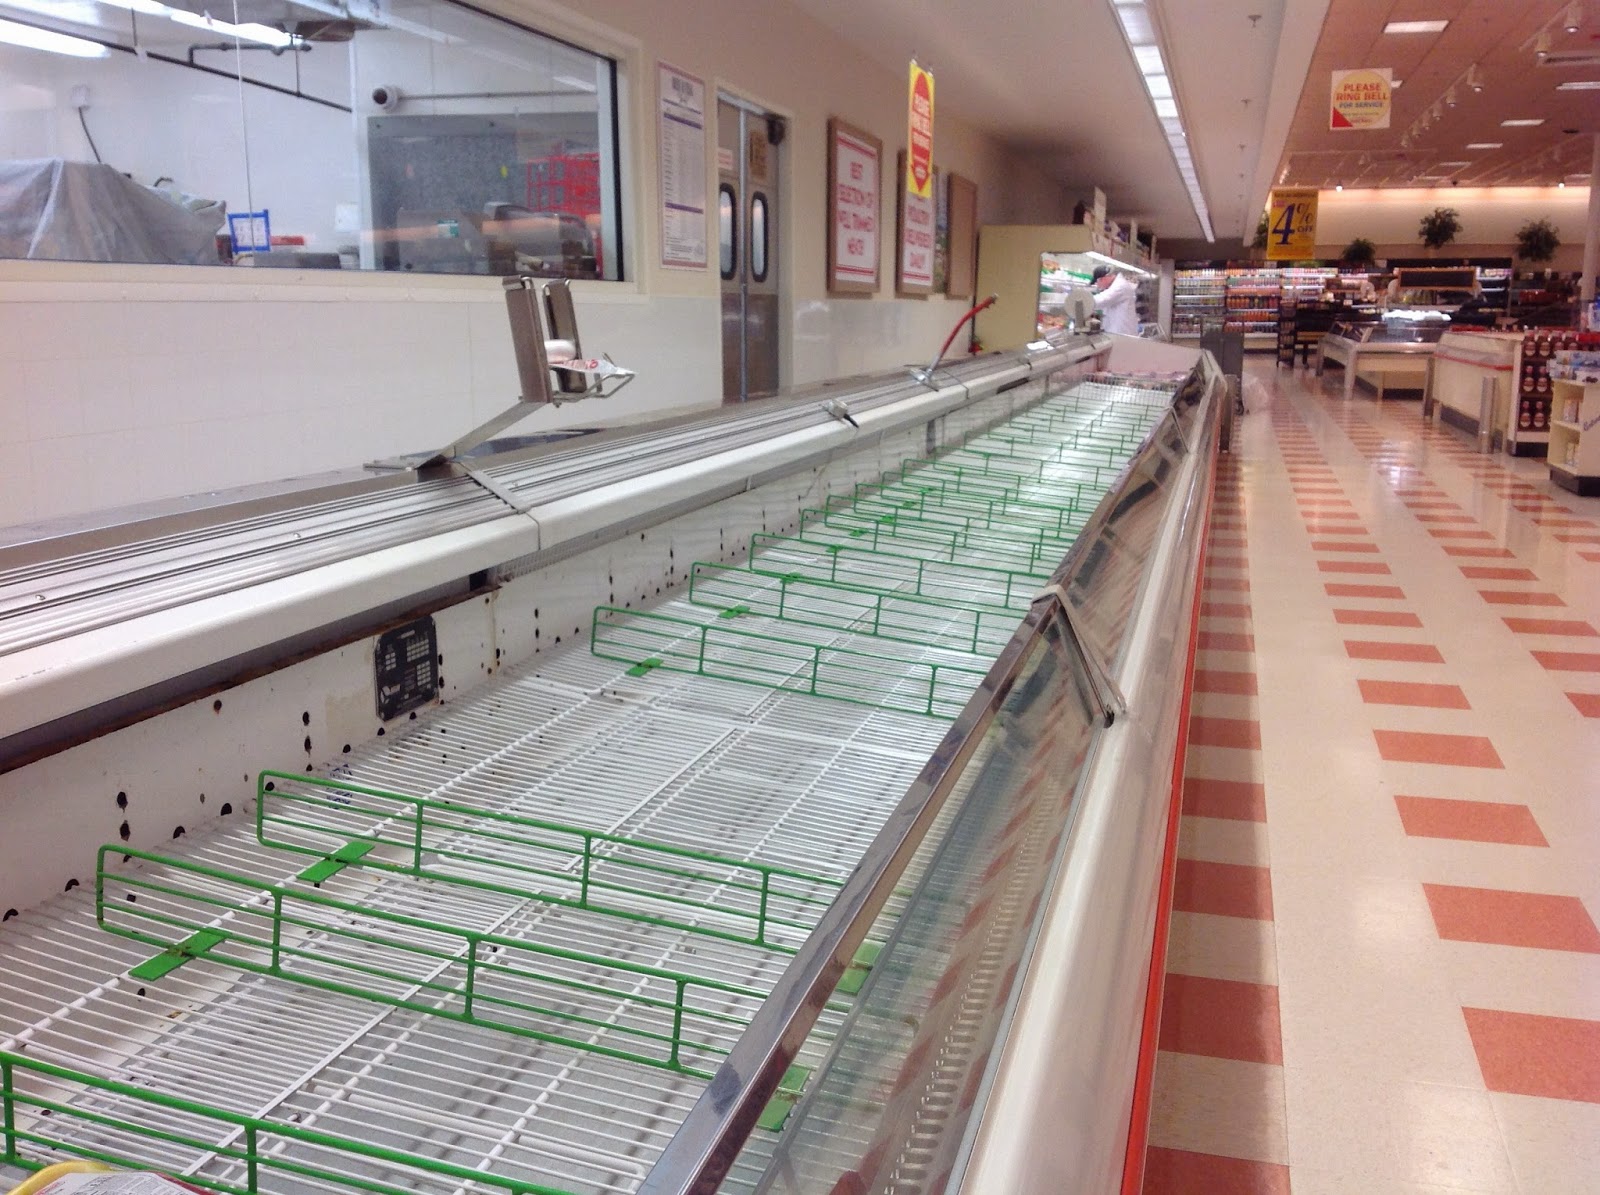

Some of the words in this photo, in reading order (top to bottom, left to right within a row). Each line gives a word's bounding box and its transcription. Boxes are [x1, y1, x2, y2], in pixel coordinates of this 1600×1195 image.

[1343, 83, 1381, 92] PLEASE
[1336, 93, 1361, 101] RING
[1364, 92, 1387, 101] BELL
